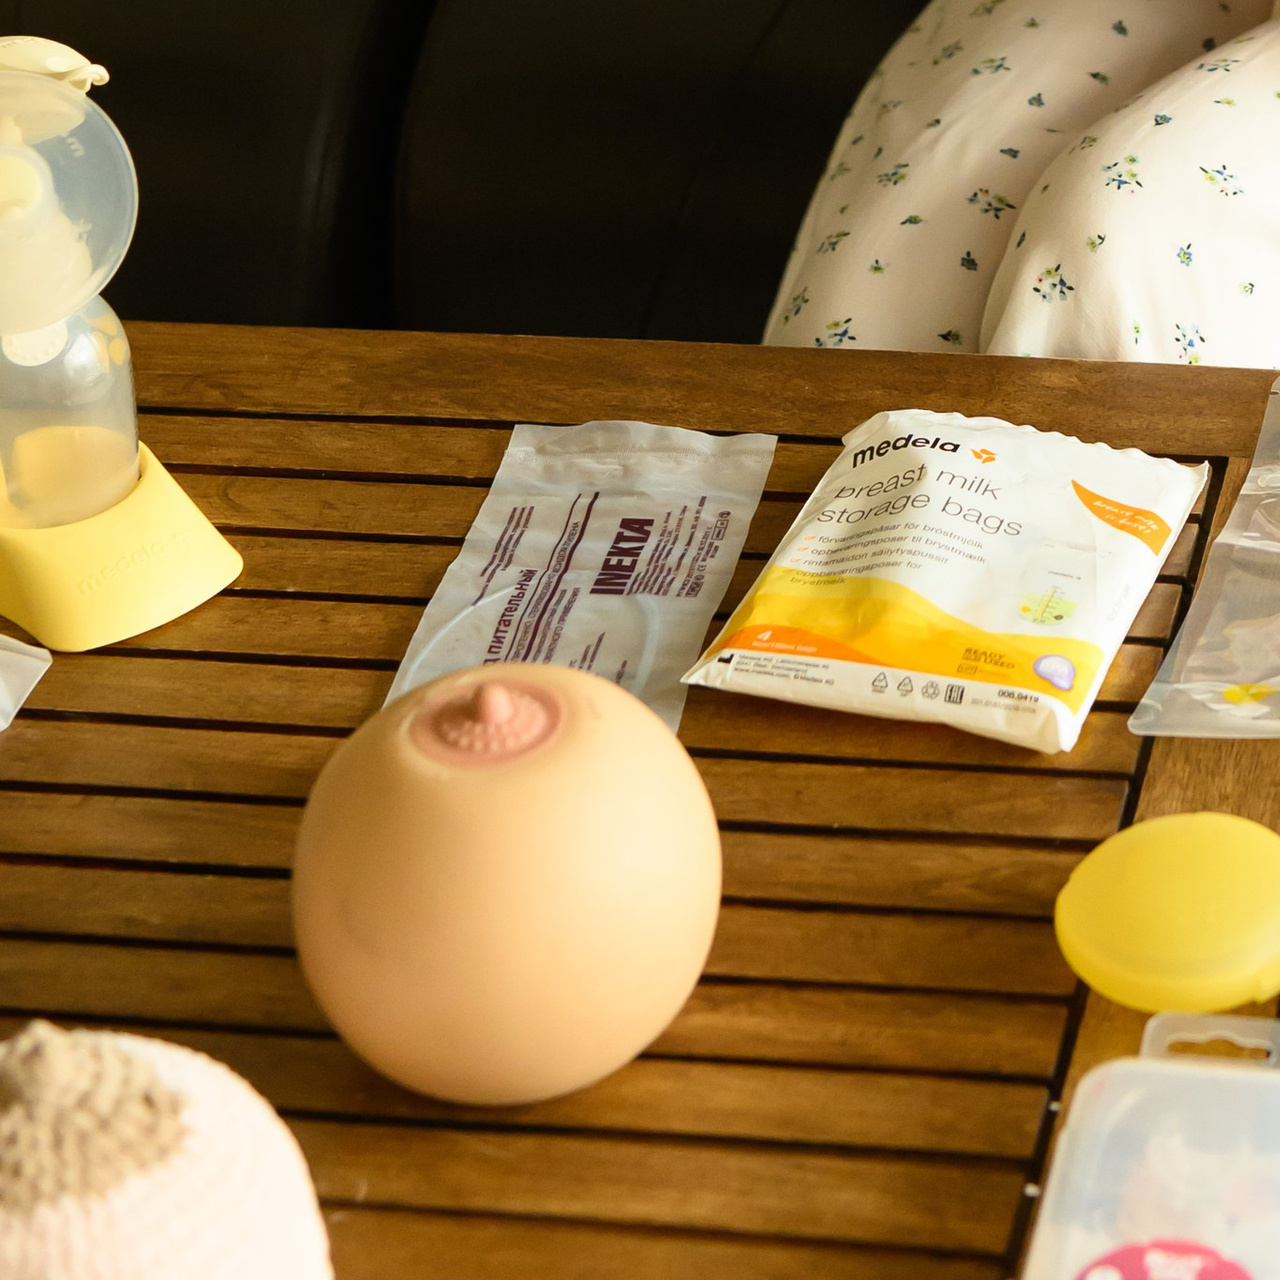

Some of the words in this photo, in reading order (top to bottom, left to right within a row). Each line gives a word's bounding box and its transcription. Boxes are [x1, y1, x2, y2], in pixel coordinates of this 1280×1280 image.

[852, 433, 961, 469] medela
[834, 463, 928, 500] breast
[935, 469, 1004, 500] milk
[817, 492, 930, 524] storage
[941, 495, 1023, 537] bags
[904, 522, 919, 530] för
[589, 517, 655, 596] INEKTA
[911, 534, 923, 544] til
[76, 541, 164, 596] medela
[905, 560, 923, 570] for
[487, 569, 538, 658] питательный
